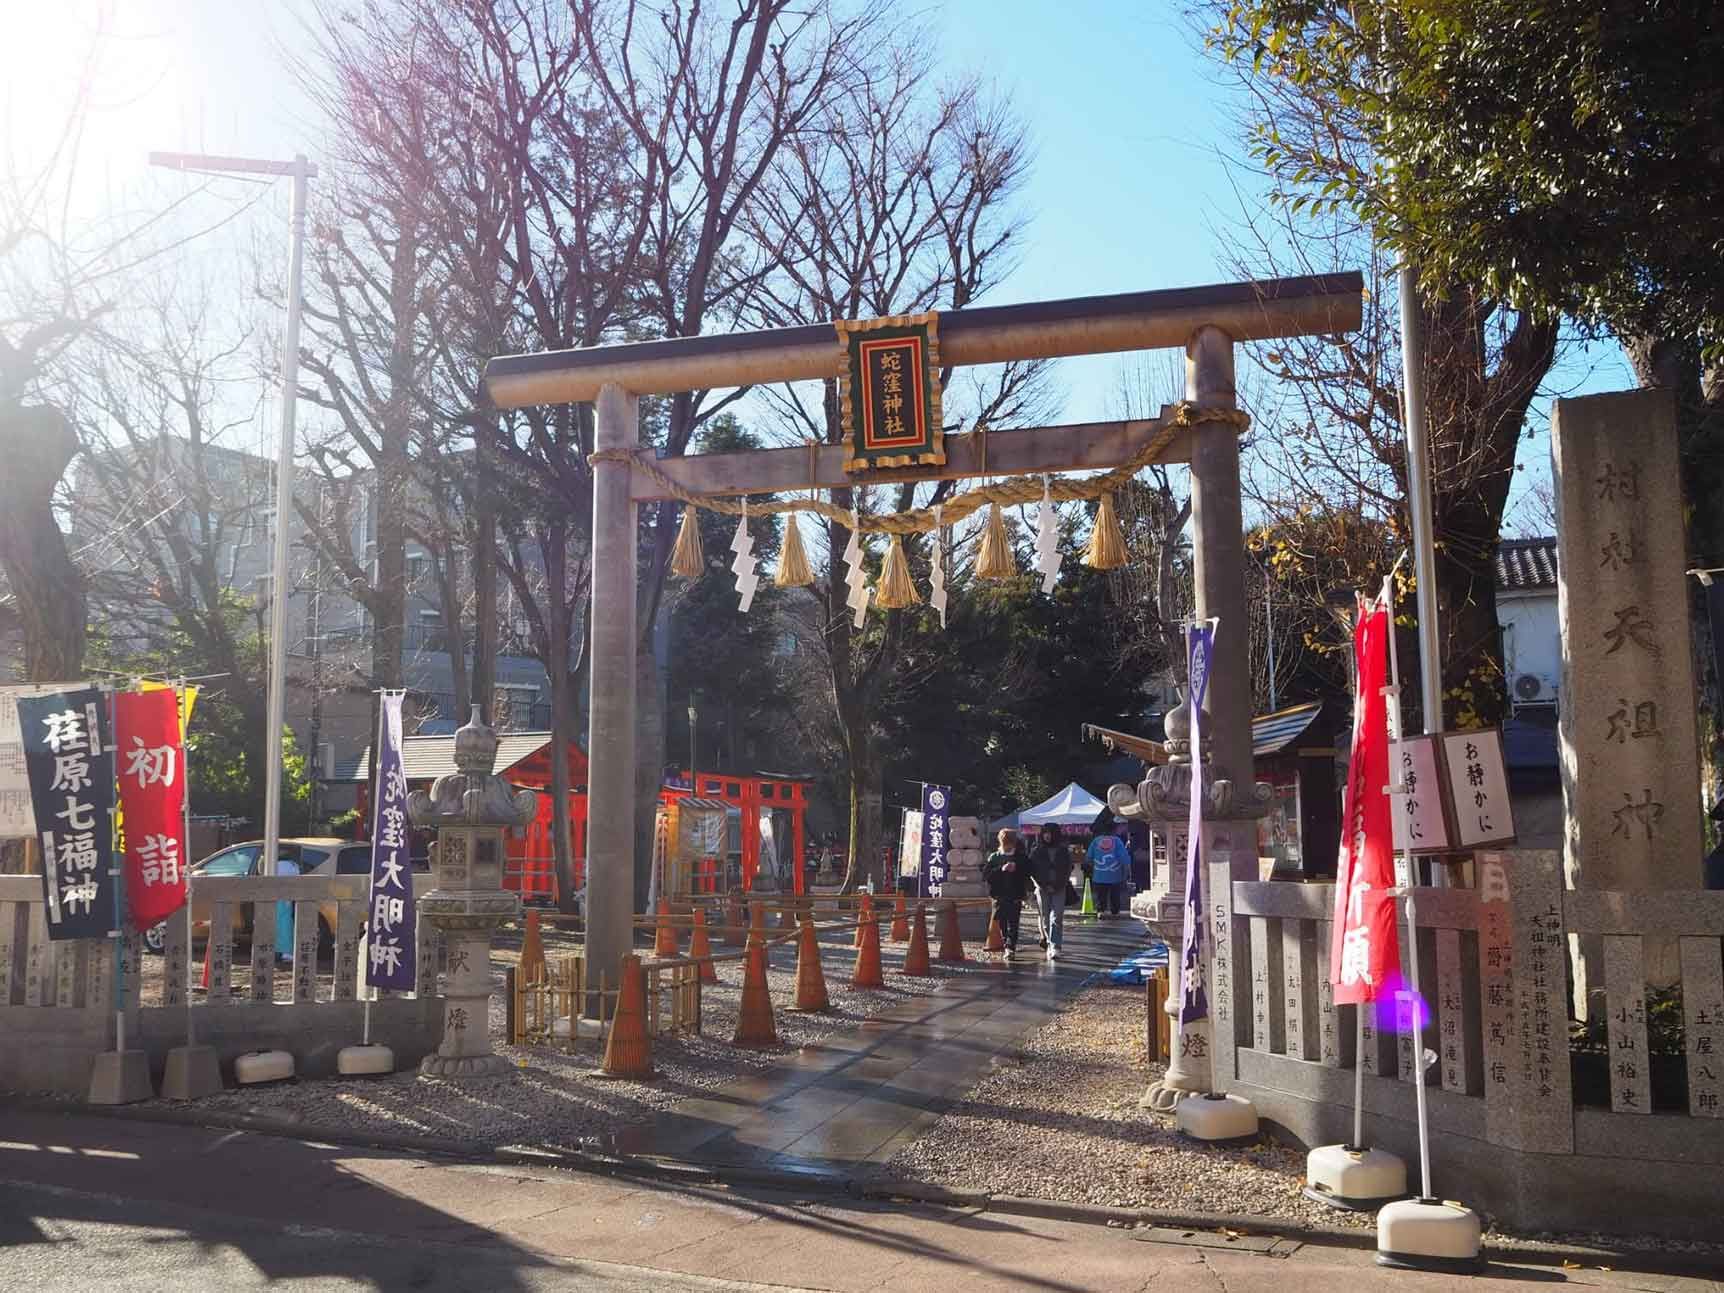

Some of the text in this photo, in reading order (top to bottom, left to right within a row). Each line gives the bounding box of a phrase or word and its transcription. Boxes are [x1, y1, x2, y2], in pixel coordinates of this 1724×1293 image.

[880, 351, 905, 436] 蛇窪神社
[41, 708, 99, 915] 荏原七福神
[125, 735, 179, 888] 初詣
[1465, 741, 1493, 832] お静かに
[1215, 904, 1229, 1021] SMK株式会社
[1615, 1006, 1638, 1107] 小山裕史
[1694, 1010, 1718, 1110] 土屋八郎
